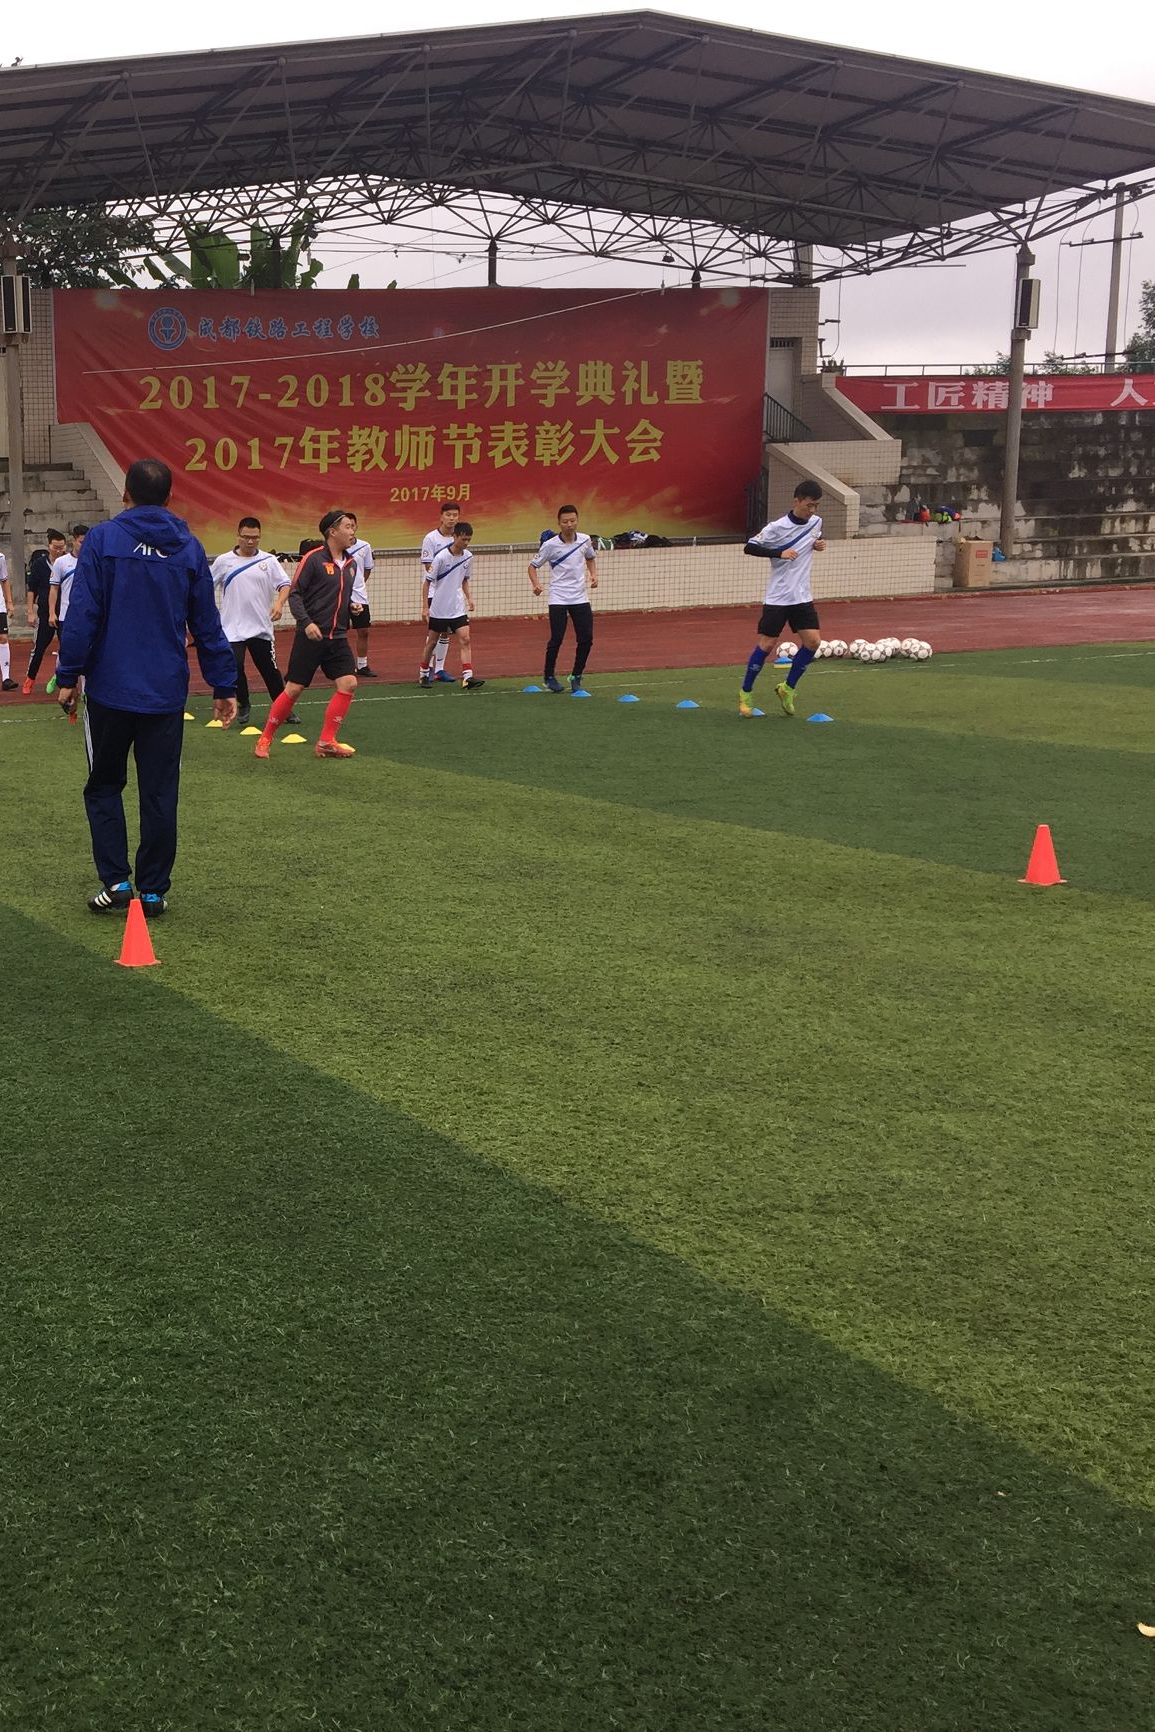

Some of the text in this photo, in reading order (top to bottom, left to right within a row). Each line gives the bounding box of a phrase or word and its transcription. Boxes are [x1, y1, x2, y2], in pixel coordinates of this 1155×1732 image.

[197, 314, 380, 342] 成都铁路工程学校
[139, 360, 704, 412] 2017-2018学年开学典礼暨
[881, 378, 1155, 410] 工匠精神 人
[184, 418, 665, 474] 2017年教师节表彰大会
[389, 483, 471, 502] 2017年9月
